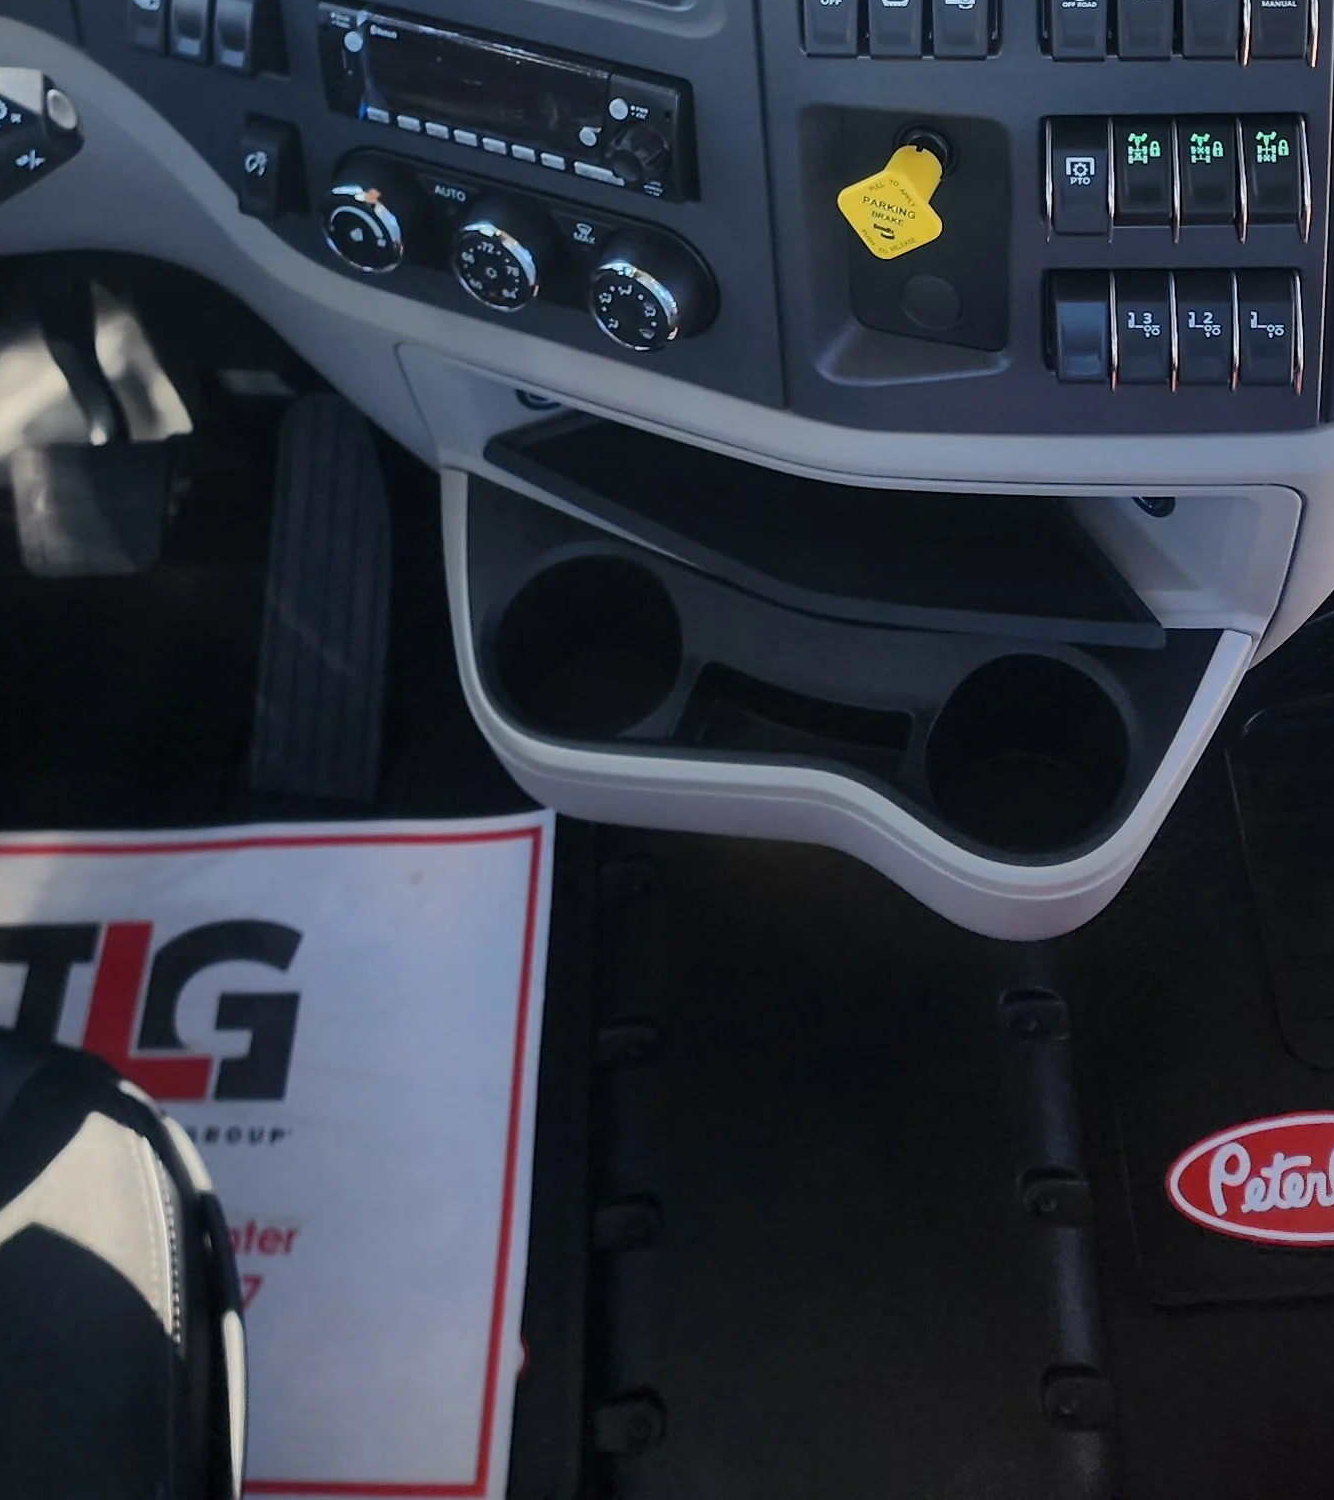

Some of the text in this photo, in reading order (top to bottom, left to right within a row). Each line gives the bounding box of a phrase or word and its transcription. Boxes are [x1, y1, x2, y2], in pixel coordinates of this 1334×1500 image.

[1261, 0, 1297, 8] MANUAL
[889, 179, 900, 187] TO
[1070, 177, 1091, 186] PTO
[434, 184, 466, 202] AUTO
[862, 196, 916, 219] PARKING
[871, 211, 905, 226] BRAKE
[481, 241, 494, 253] 72
[1142, 312, 1153, 324] 3
[1203, 312, 1213, 323] 2
